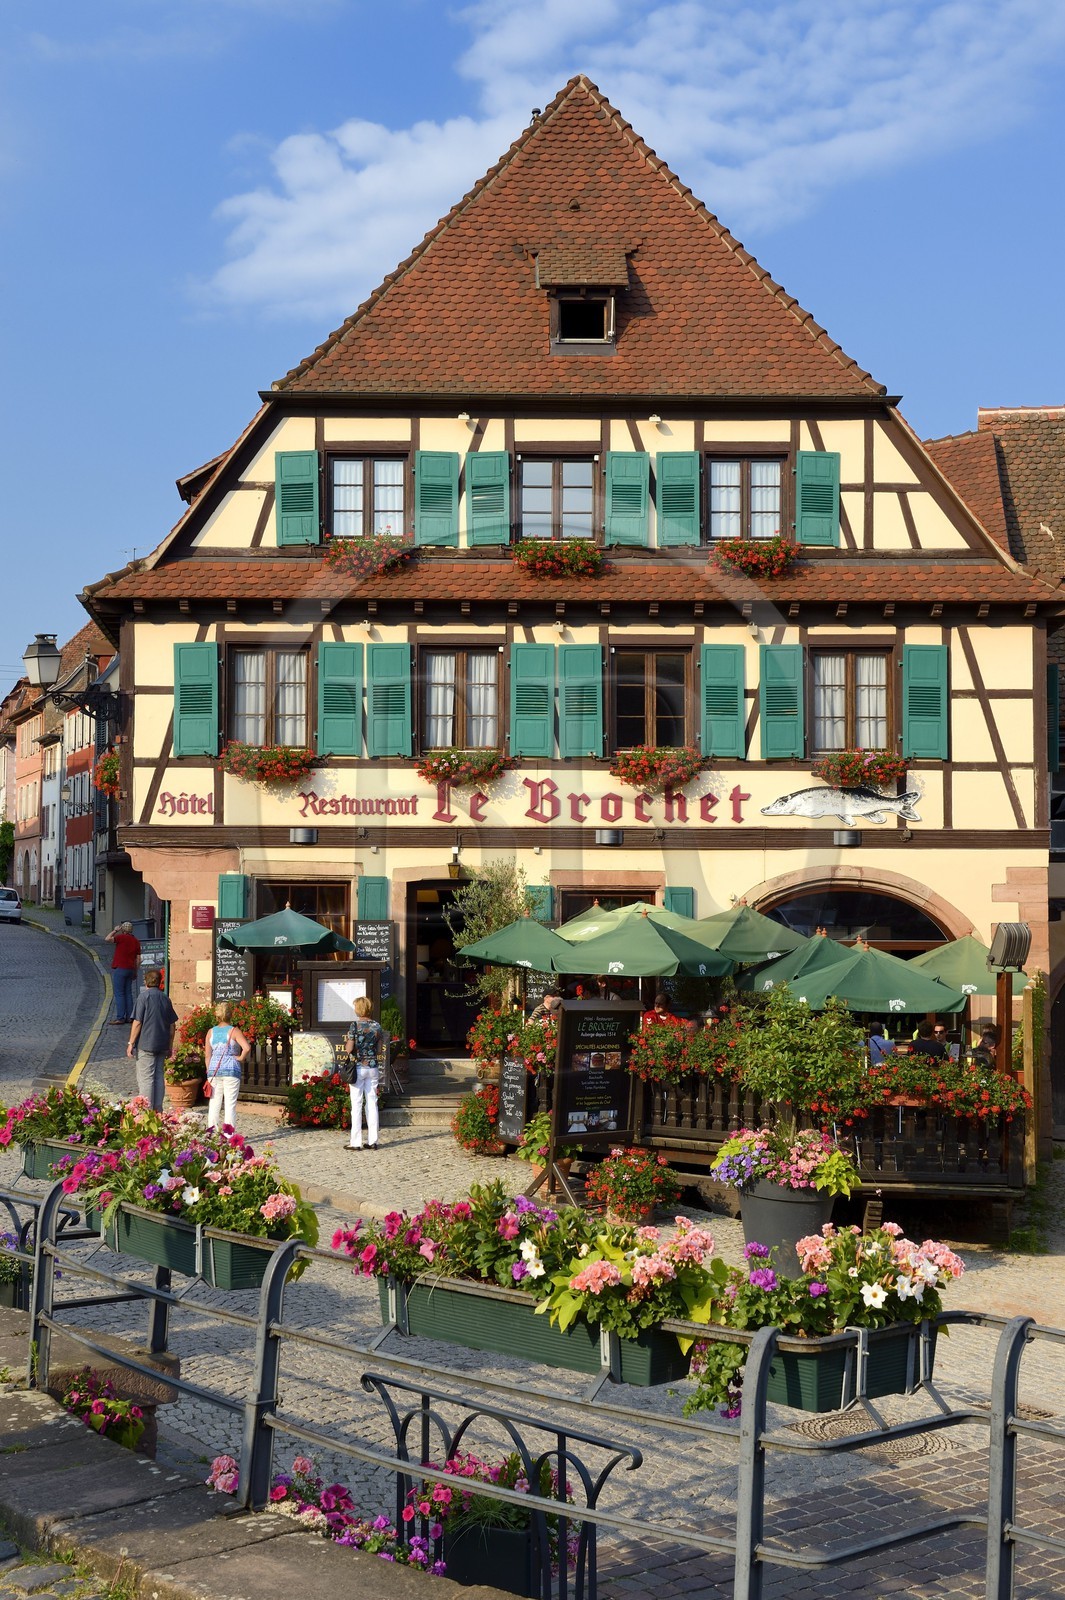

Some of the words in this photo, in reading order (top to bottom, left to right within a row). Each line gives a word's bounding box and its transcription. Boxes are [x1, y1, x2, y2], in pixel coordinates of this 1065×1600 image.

[157, 791, 215, 817] Hôtel
[298, 791, 419, 818] Restaurant
[432, 778, 489, 823] Le
[522, 776, 751, 824] Brochet
[577, 1022, 587, 1032] LE
[588, 1021, 621, 1032] BROCHET
